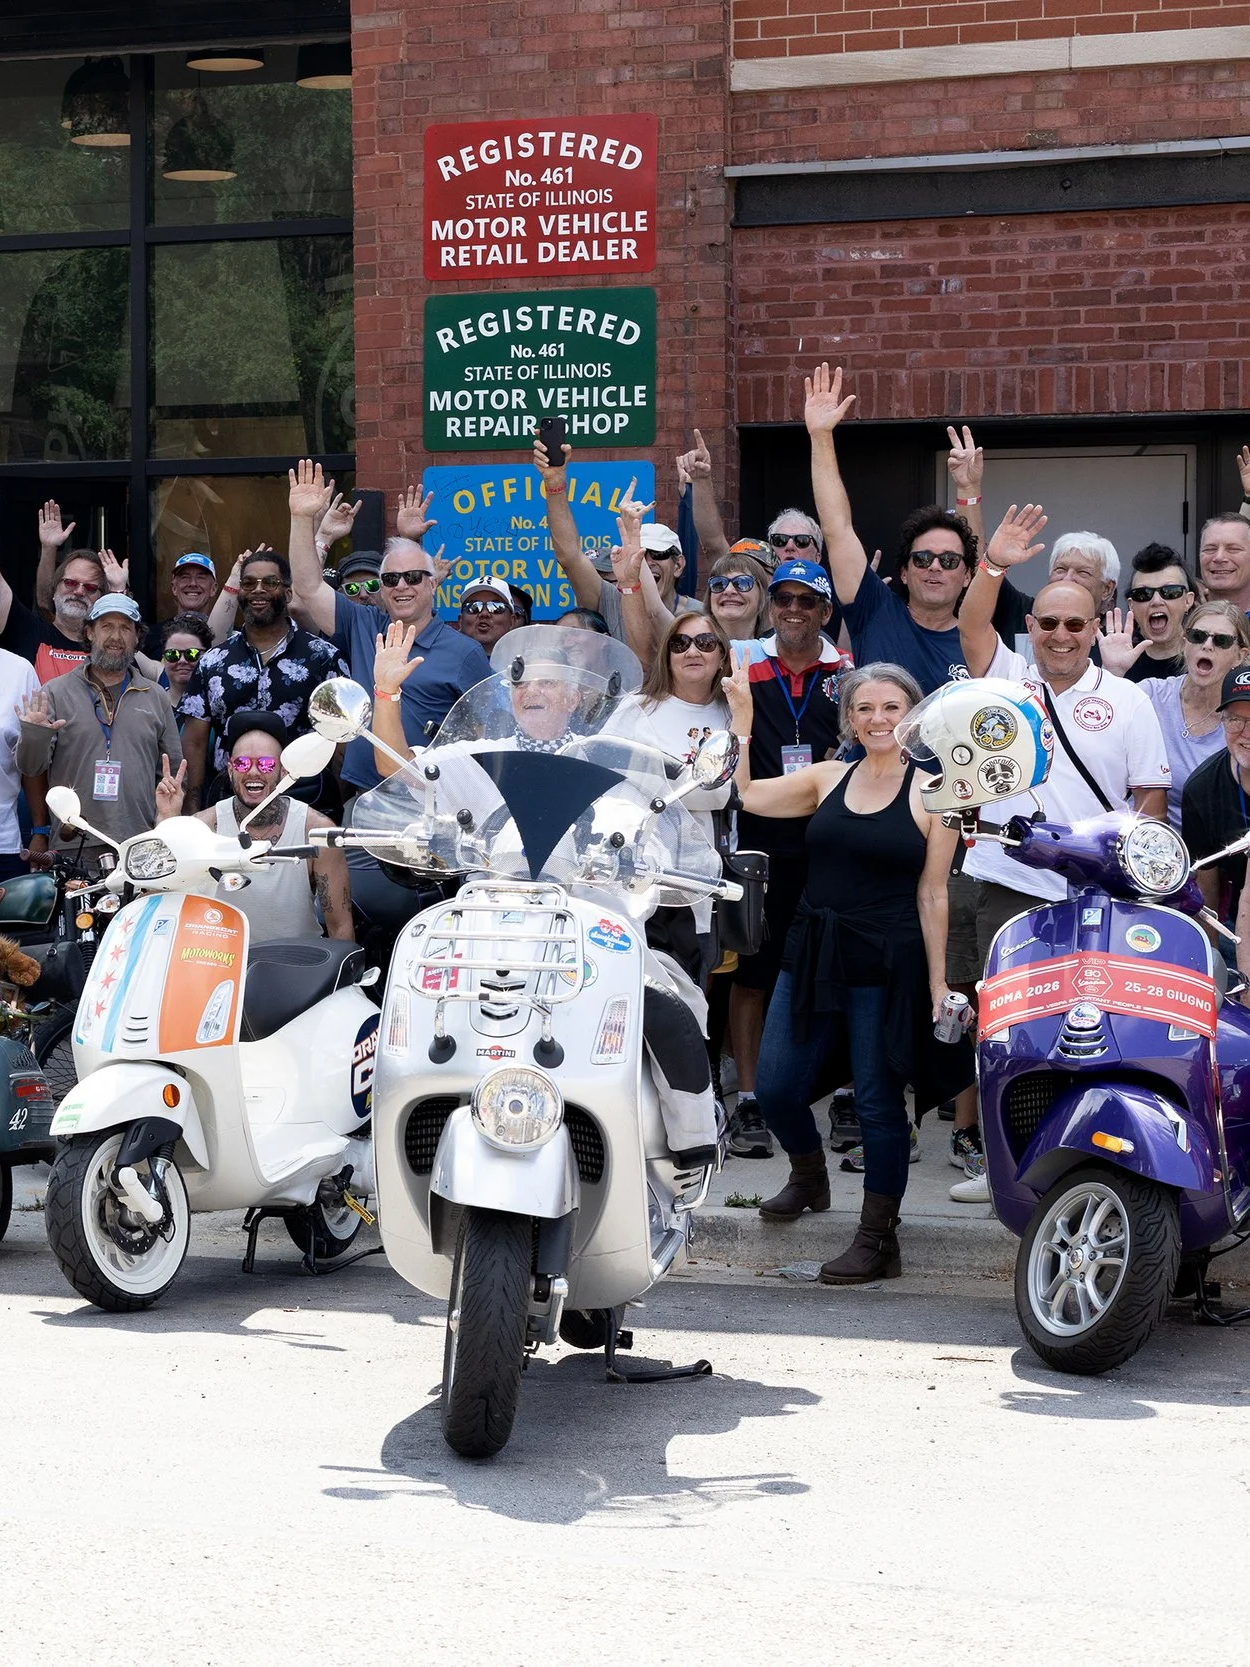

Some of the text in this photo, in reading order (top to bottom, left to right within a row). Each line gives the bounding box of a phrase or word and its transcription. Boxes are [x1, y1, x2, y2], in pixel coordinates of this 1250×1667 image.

[437, 132, 642, 181] REGISTERED
[505, 166, 573, 186] No. 461
[465, 188, 613, 210] STATE OF ILLINOIS
[431, 210, 648, 241] MOTOR VEHICLE
[440, 238, 638, 267] RETAIL DEALER
[435, 306, 641, 353] REGISTERED
[510, 343, 565, 358] No. 461
[464, 362, 612, 381] STATE OF ILLINOIS
[429, 385, 647, 412] MOTOR VEHICLE
[446, 415, 537, 437] REPAIR
[511, 516, 533, 530] No.
[465, 537, 513, 552] STATE
[517, 536, 539, 551] OF
[447, 559, 527, 580] OTOR
[191, 930, 229, 939] RACING
[180, 947, 236, 968] MOTOWORKS
[1000, 936, 1040, 959] Vespa
[989, 991, 1023, 1012] ROMA
[1026, 980, 1061, 998] 2026
[1046, 996, 1142, 1010] VESPA IMPORTANT PEOPLE
[1124, 981, 1213, 1013] 25-28 GIUGNO
[477, 1049, 515, 1057] MARTINI
[8, 1107, 28, 1131] 42
